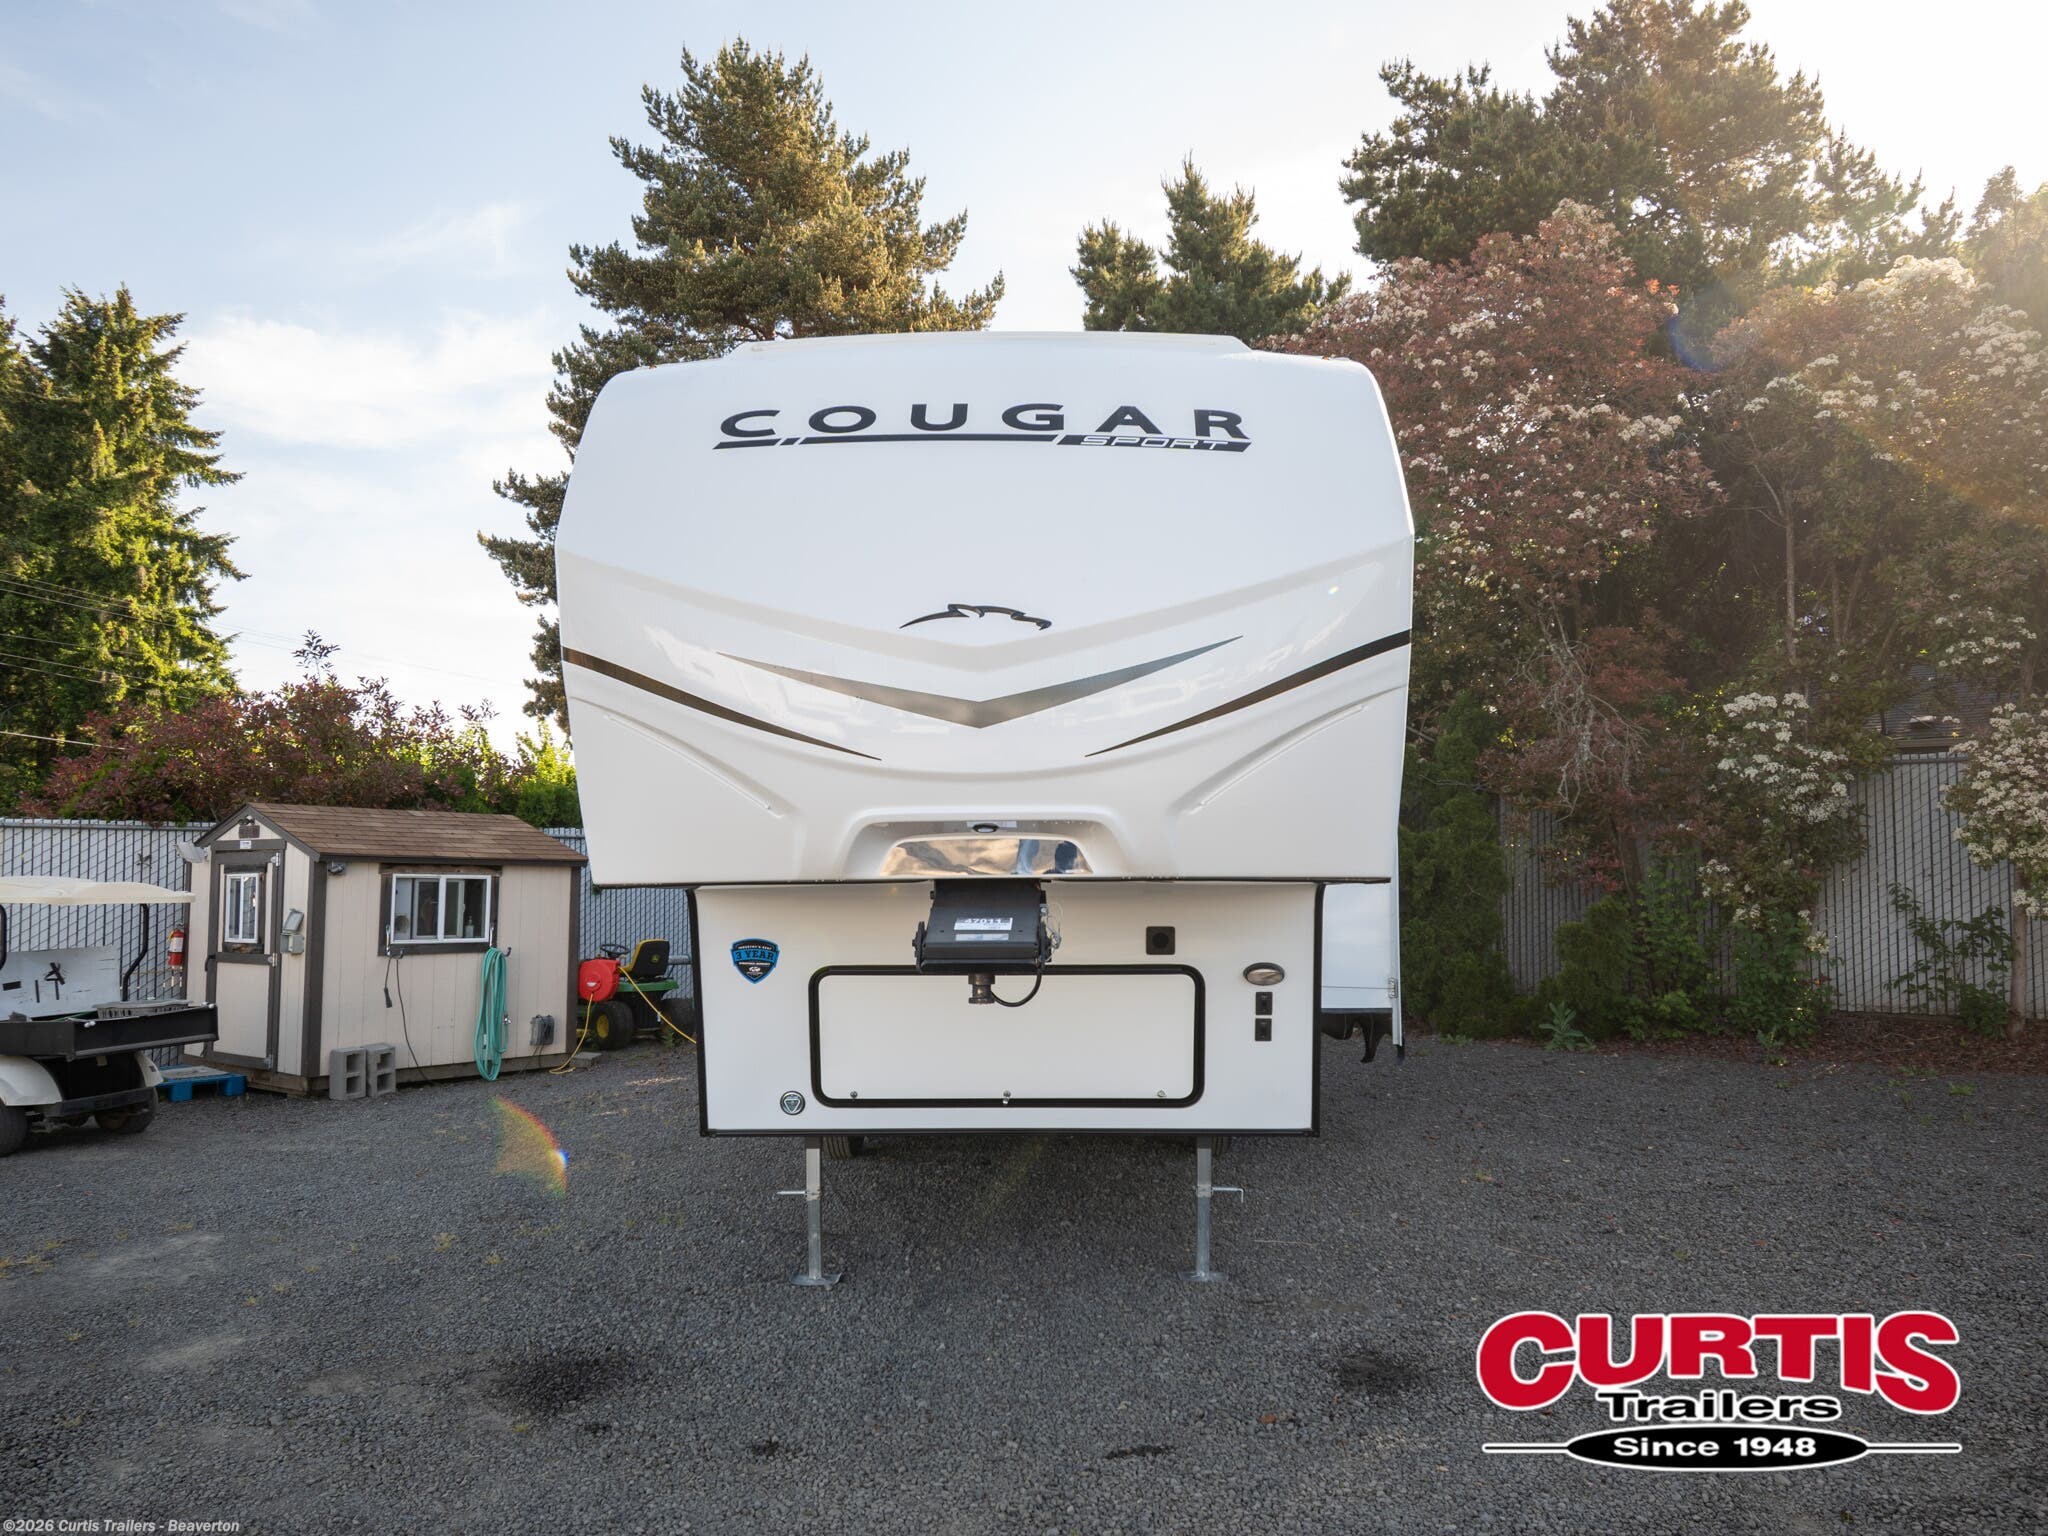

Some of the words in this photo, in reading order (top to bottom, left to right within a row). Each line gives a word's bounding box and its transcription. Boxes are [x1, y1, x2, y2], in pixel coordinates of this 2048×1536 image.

[720, 403, 1250, 439] COUGAR
[1080, 435, 1228, 450] SPORT
[745, 950, 774, 961] YEAR
